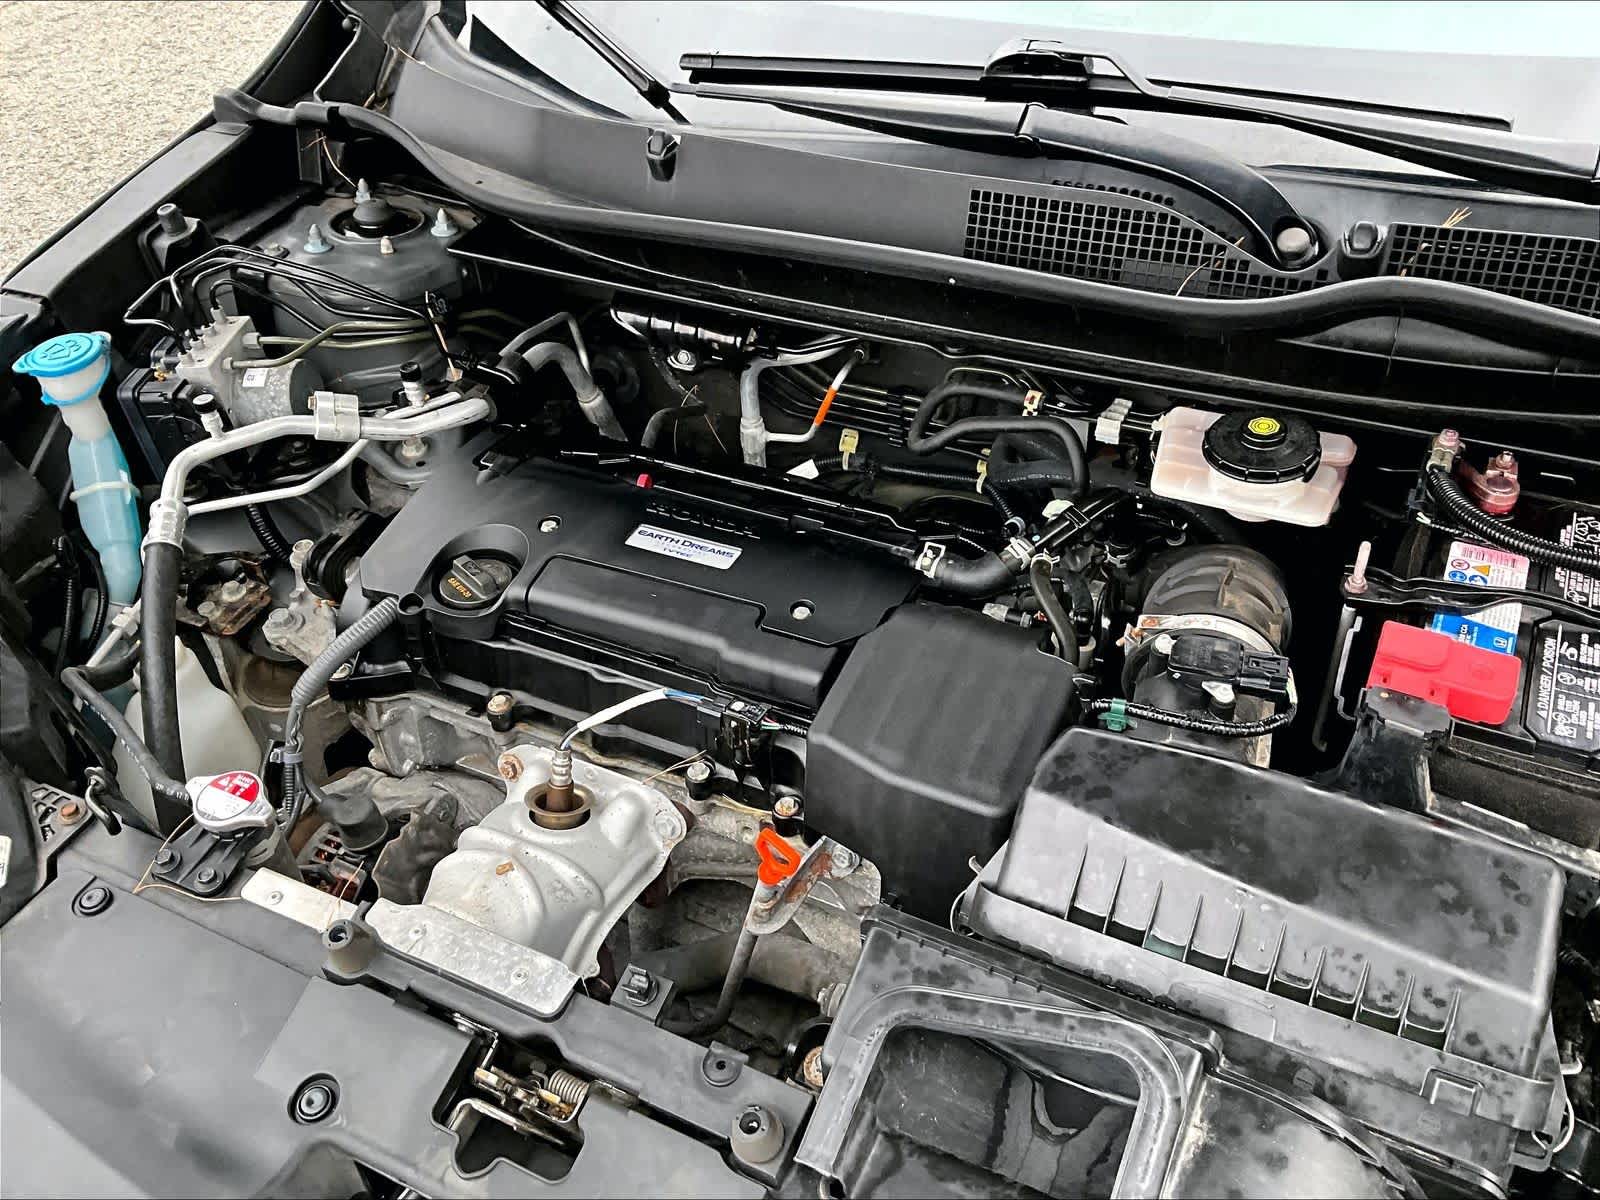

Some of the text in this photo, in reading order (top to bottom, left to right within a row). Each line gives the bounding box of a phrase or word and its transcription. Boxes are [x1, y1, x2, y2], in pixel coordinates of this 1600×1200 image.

[638, 529, 680, 545] EARTH
[681, 540, 735, 558] DREAMS
[1543, 637, 1557, 668] POISON
[1537, 674, 1551, 710] DANGER
